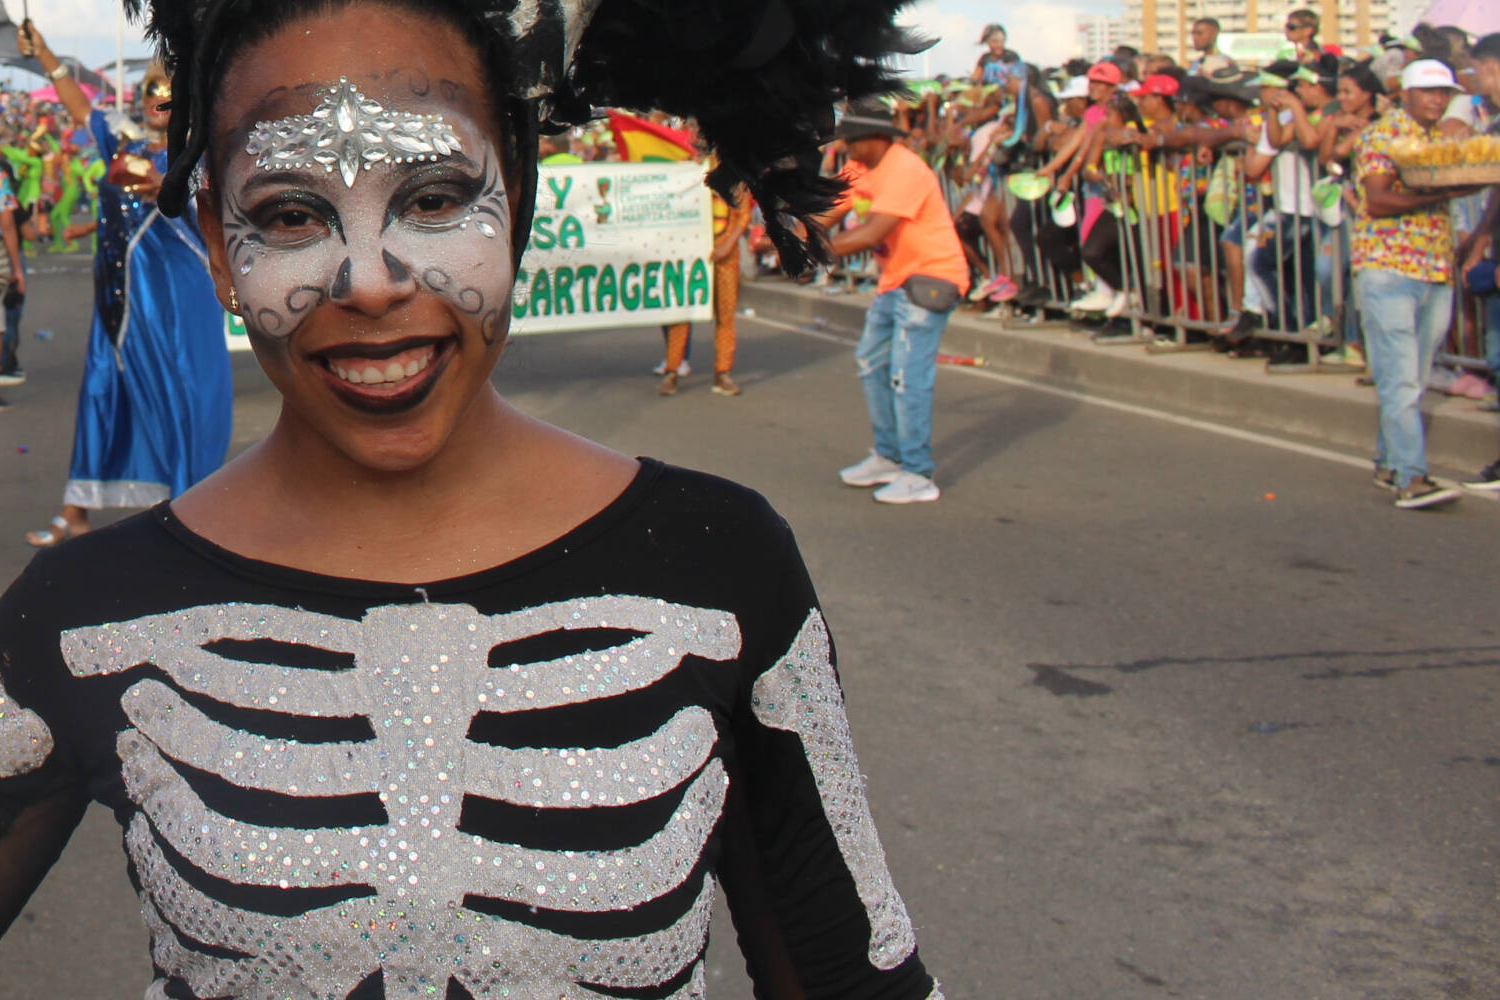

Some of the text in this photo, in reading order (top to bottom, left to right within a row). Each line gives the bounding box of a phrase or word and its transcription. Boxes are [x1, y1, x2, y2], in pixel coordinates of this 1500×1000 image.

[548, 176, 573, 209] Y
[527, 214, 585, 250] SA
[512, 258, 709, 319] CARTAGENA
